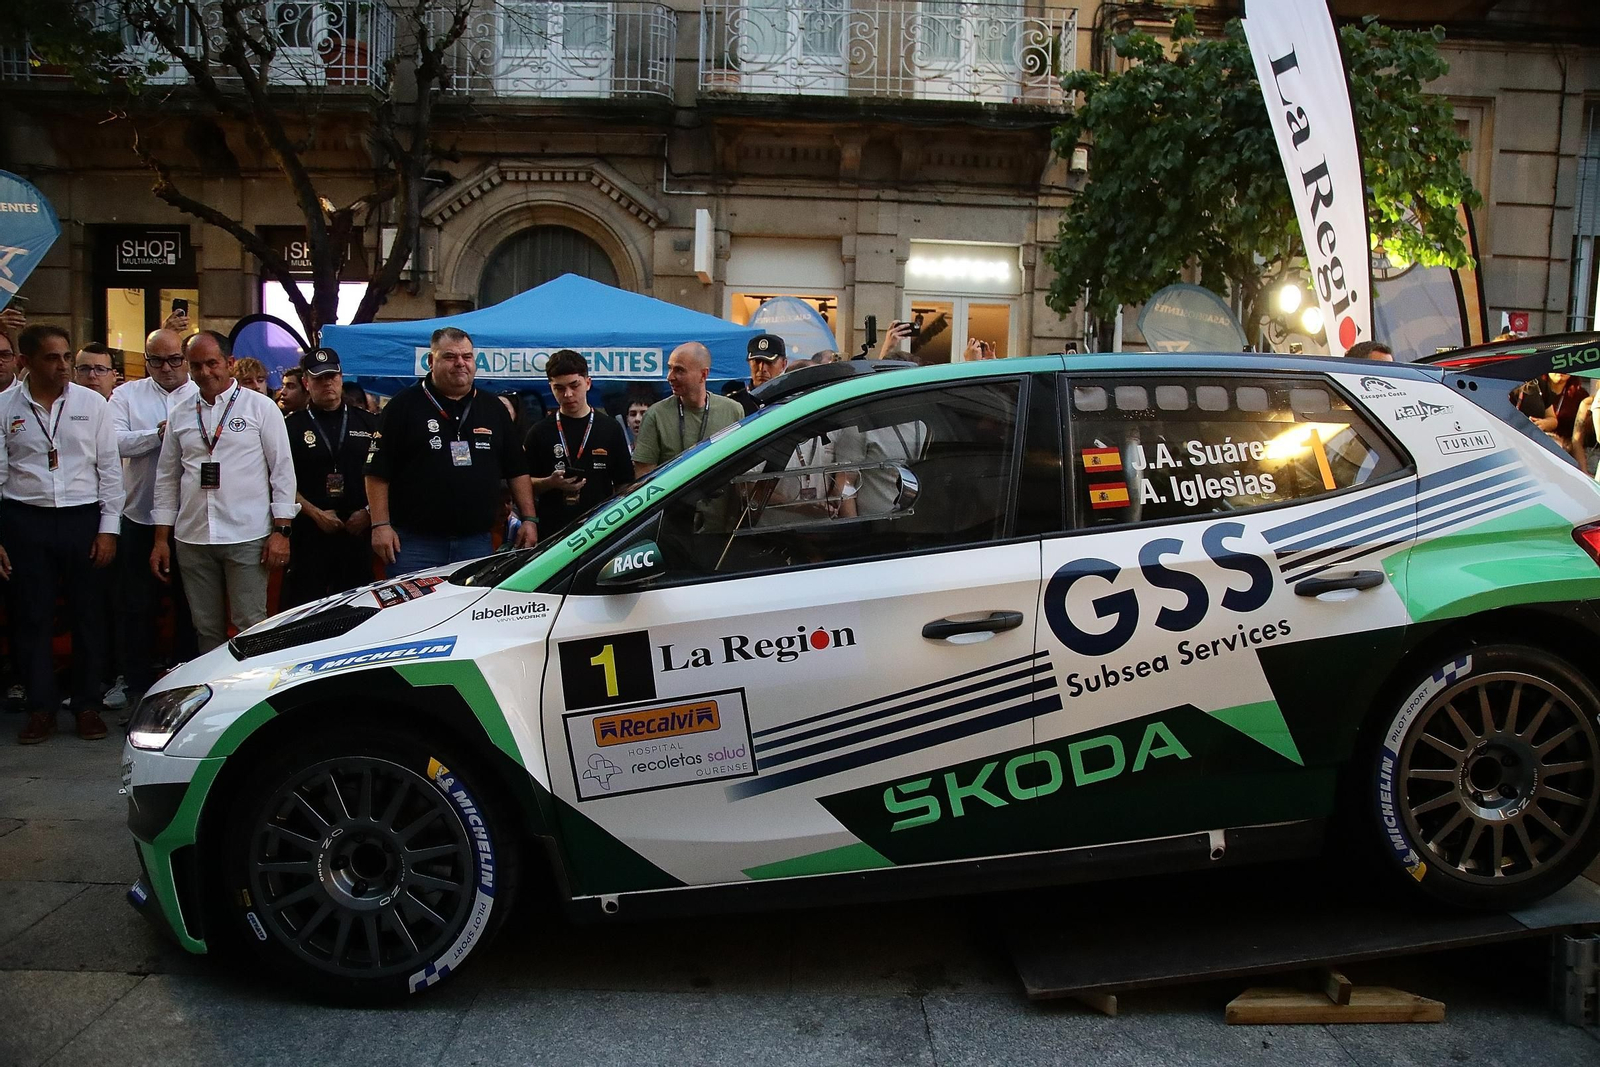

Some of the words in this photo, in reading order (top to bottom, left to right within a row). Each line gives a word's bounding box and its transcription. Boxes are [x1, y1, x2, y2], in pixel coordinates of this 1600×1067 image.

[1268, 43, 1311, 151] La
[1300, 154, 1362, 350] Regió
[122, 240, 175, 257] SHOP
[123, 257, 167, 265] MULTIMARCA
[290, 241, 310, 259] SH
[420, 350, 658, 373] CADELOENTES
[1388, 390, 1407, 398] Costa
[1395, 404, 1454, 418] Rallycar
[1442, 434, 1489, 450] TURINI
[1132, 443, 1183, 471] J.A.
[1140, 478, 1167, 505] A.
[1170, 470, 1277, 507] Iglesias
[566, 484, 666, 553] SKODA
[613, 550, 655, 574] RACC
[1044, 522, 1274, 656] GSS
[472, 602, 550, 621] labellavita.
[318, 644, 452, 671] MICHELIN
[658, 643, 714, 673] La
[719, 625, 857, 664] Región
[1066, 655, 1170, 698] Subsea
[1177, 618, 1292, 667] Services
[590, 643, 619, 697] 1
[619, 709, 695, 738] Recalvi
[1391, 719, 1408, 744] PILOT
[1406, 687, 1429, 716] SPORT
[627, 743, 684, 756] HOSPITAL
[631, 754, 703, 775] recoletas
[707, 744, 747, 763] salud
[695, 763, 749, 777] OURENSE
[883, 721, 1192, 832] SKODA
[1379, 756, 1406, 851] MICHELIN
[452, 790, 493, 887] MICHELIN
[473, 902, 487, 930] PILOT
[453, 930, 476, 960] SPORT
